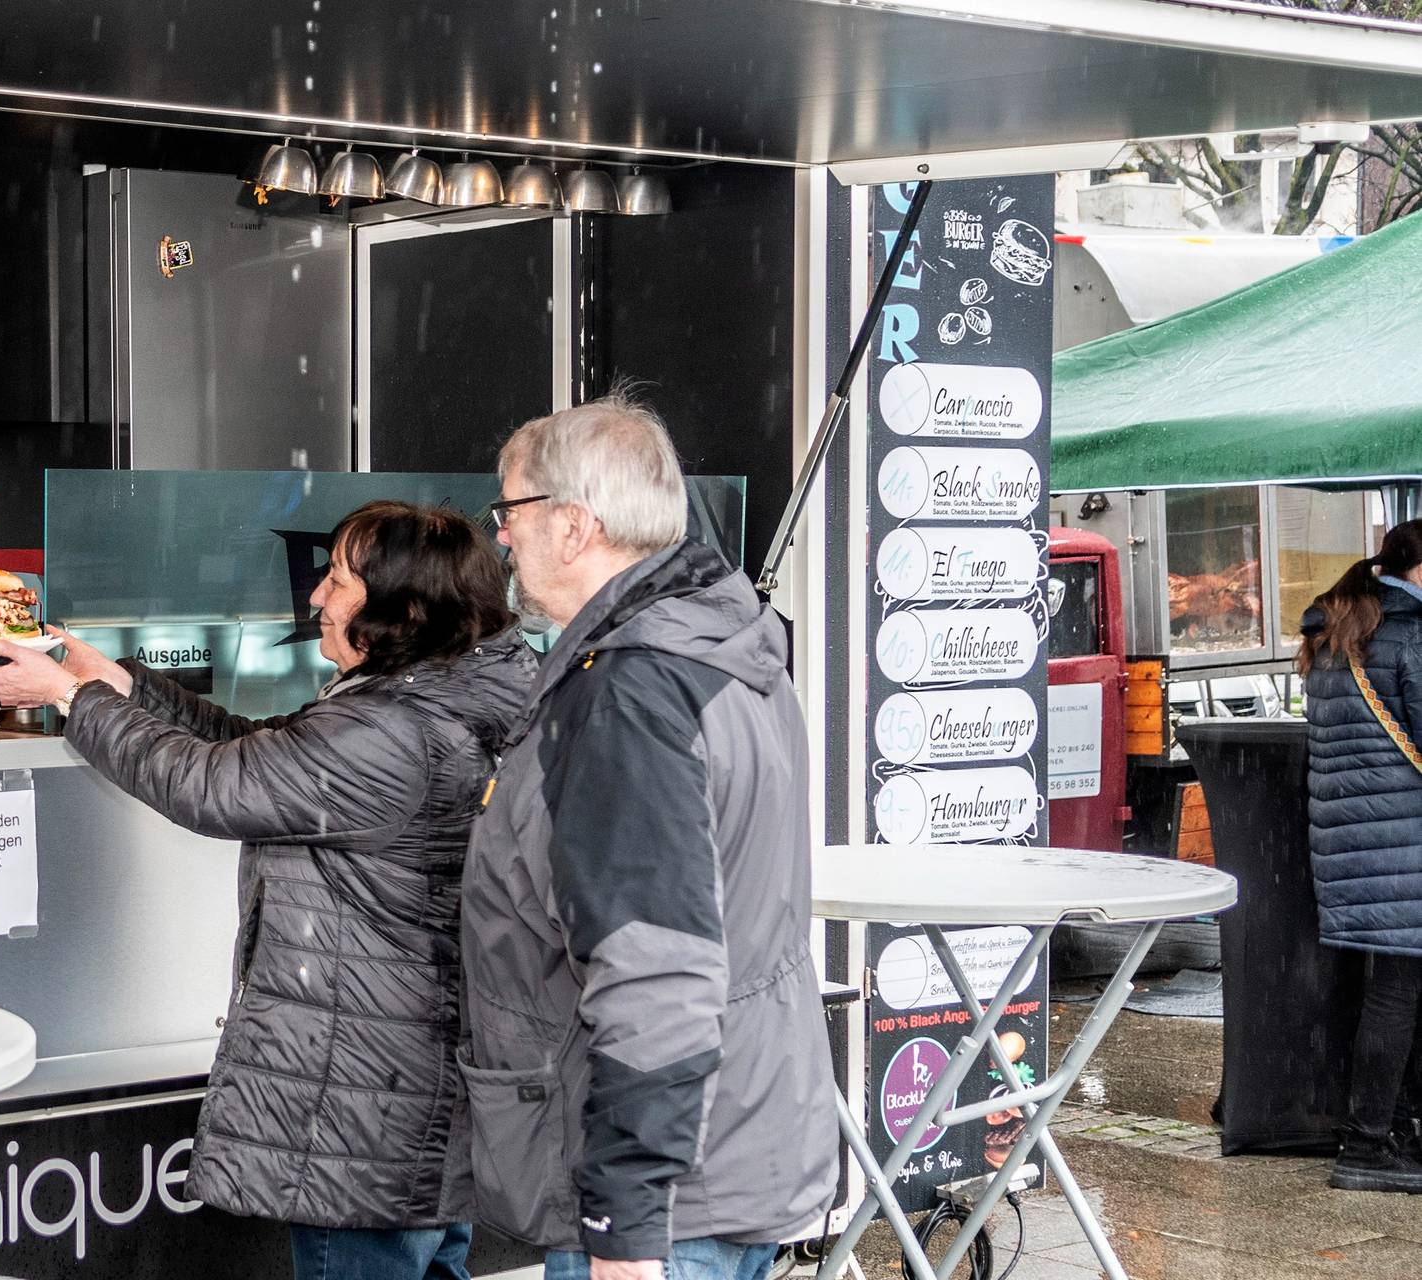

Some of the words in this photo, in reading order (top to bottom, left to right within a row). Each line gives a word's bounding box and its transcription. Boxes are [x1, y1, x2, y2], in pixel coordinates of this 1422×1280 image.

[943, 220, 984, 242] BURGER
[934, 387, 1013, 430] Carpaccio
[934, 465, 981, 501] Black
[986, 467, 1040, 502] Smoke
[932, 546, 956, 577] El
[957, 550, 1006, 592] Fuego
[137, 645, 212, 667] Ausgabe
[931, 626, 1018, 660] Chillicheese
[930, 706, 1035, 753] Cheeseburger
[1064, 780, 1076, 788] 98
[1079, 778, 1096, 788] 352
[931, 786, 1027, 831] Hamburger
[874, 1018, 895, 1033] 100
[896, 1018, 908, 1030] %
[910, 1013, 941, 1028] Black
